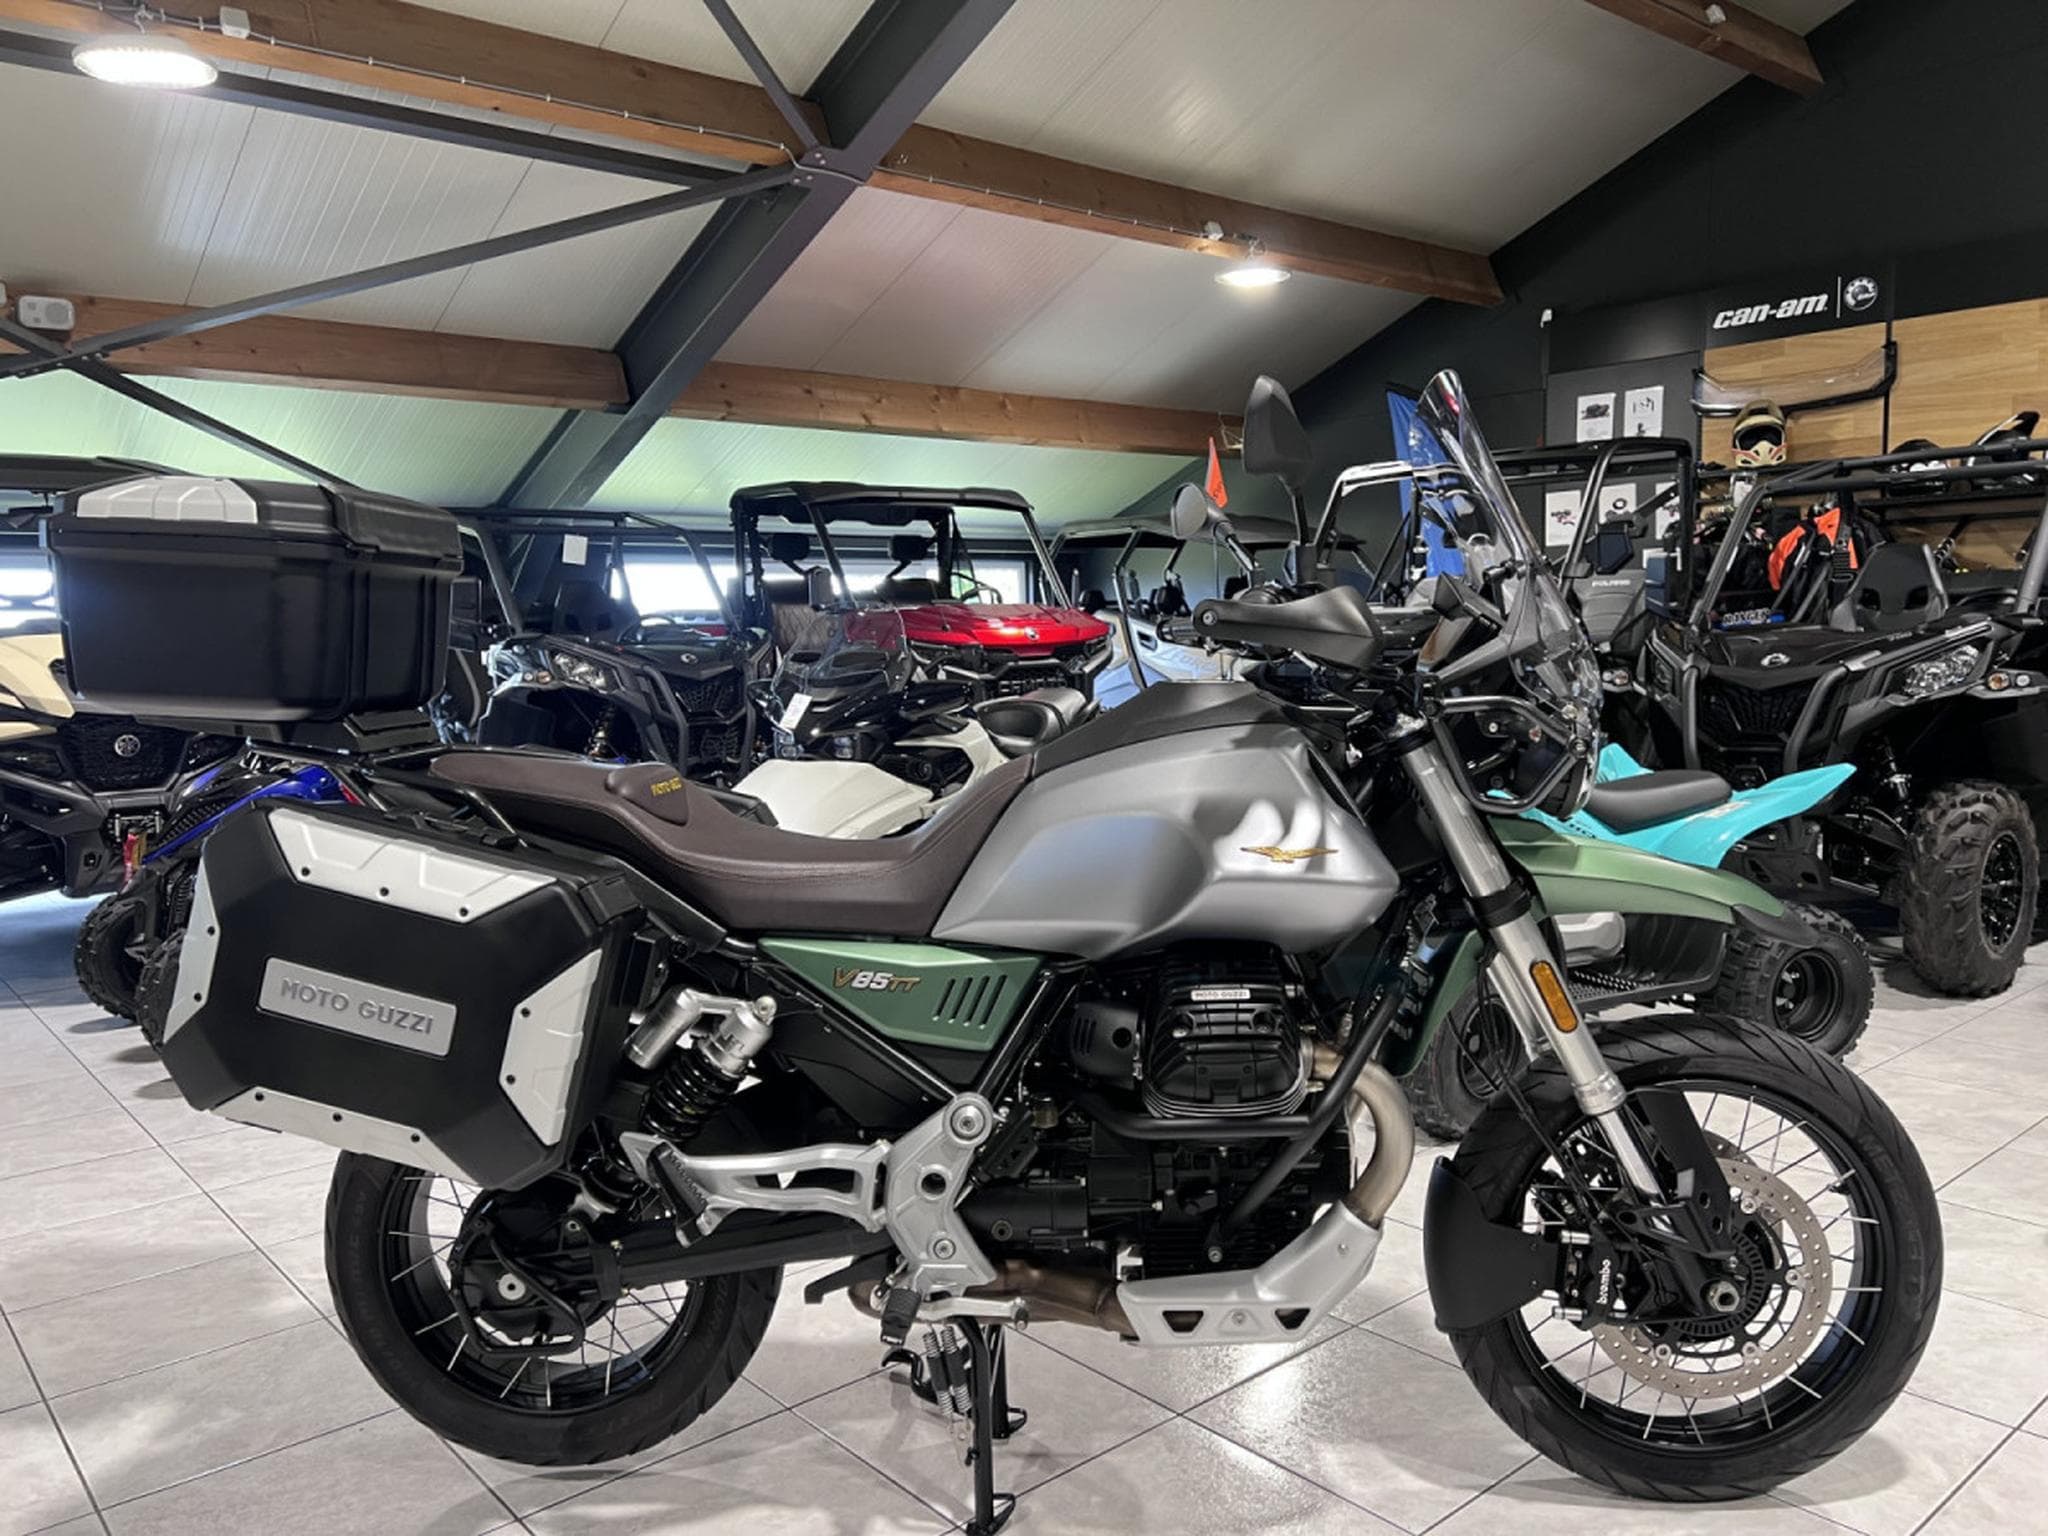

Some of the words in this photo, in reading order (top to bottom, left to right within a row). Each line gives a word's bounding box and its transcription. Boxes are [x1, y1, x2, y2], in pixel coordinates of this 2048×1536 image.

[1713, 294, 1828, 329] can-am
[280, 978, 350, 1011] MOTO
[357, 1000, 434, 1035] GUZZI
[1596, 1259, 1611, 1304] brembo
